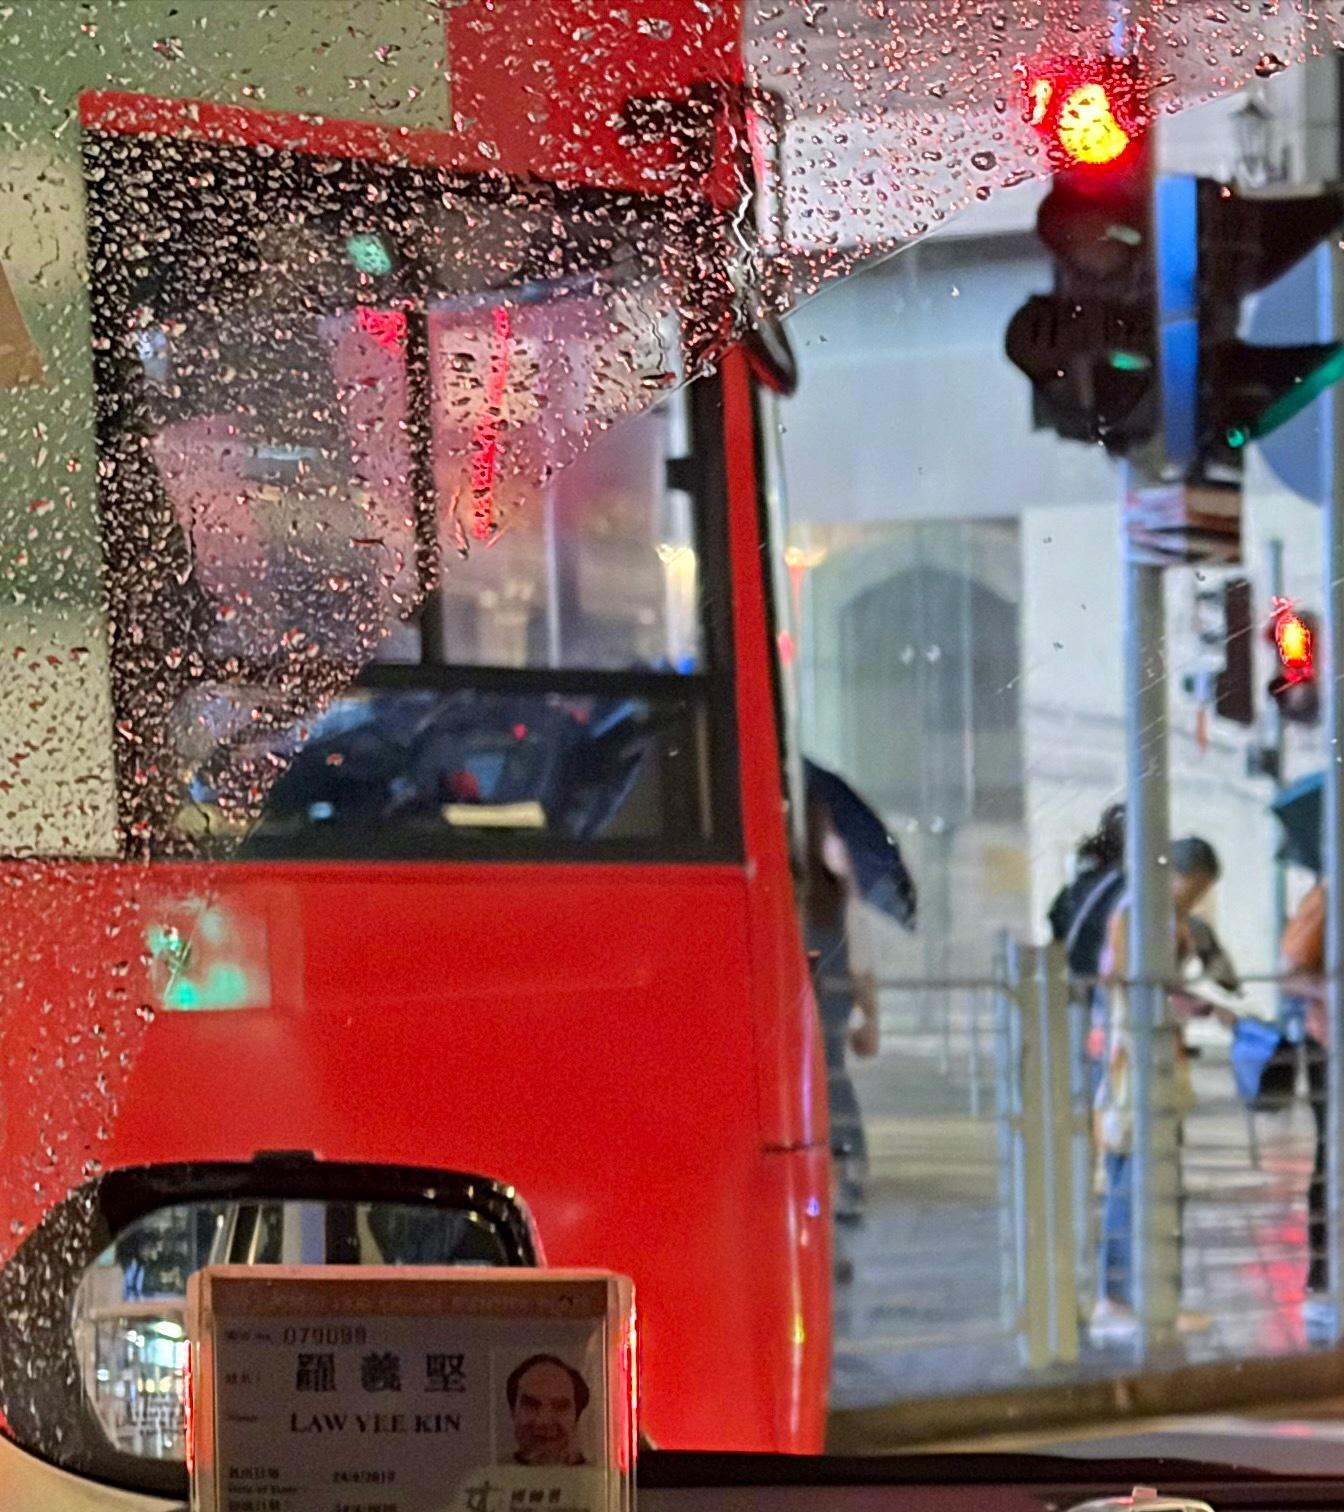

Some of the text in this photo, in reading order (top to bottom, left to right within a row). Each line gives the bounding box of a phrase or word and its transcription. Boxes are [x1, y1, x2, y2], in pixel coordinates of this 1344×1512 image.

[291, 1412, 461, 1434] LAW YEE KIN
